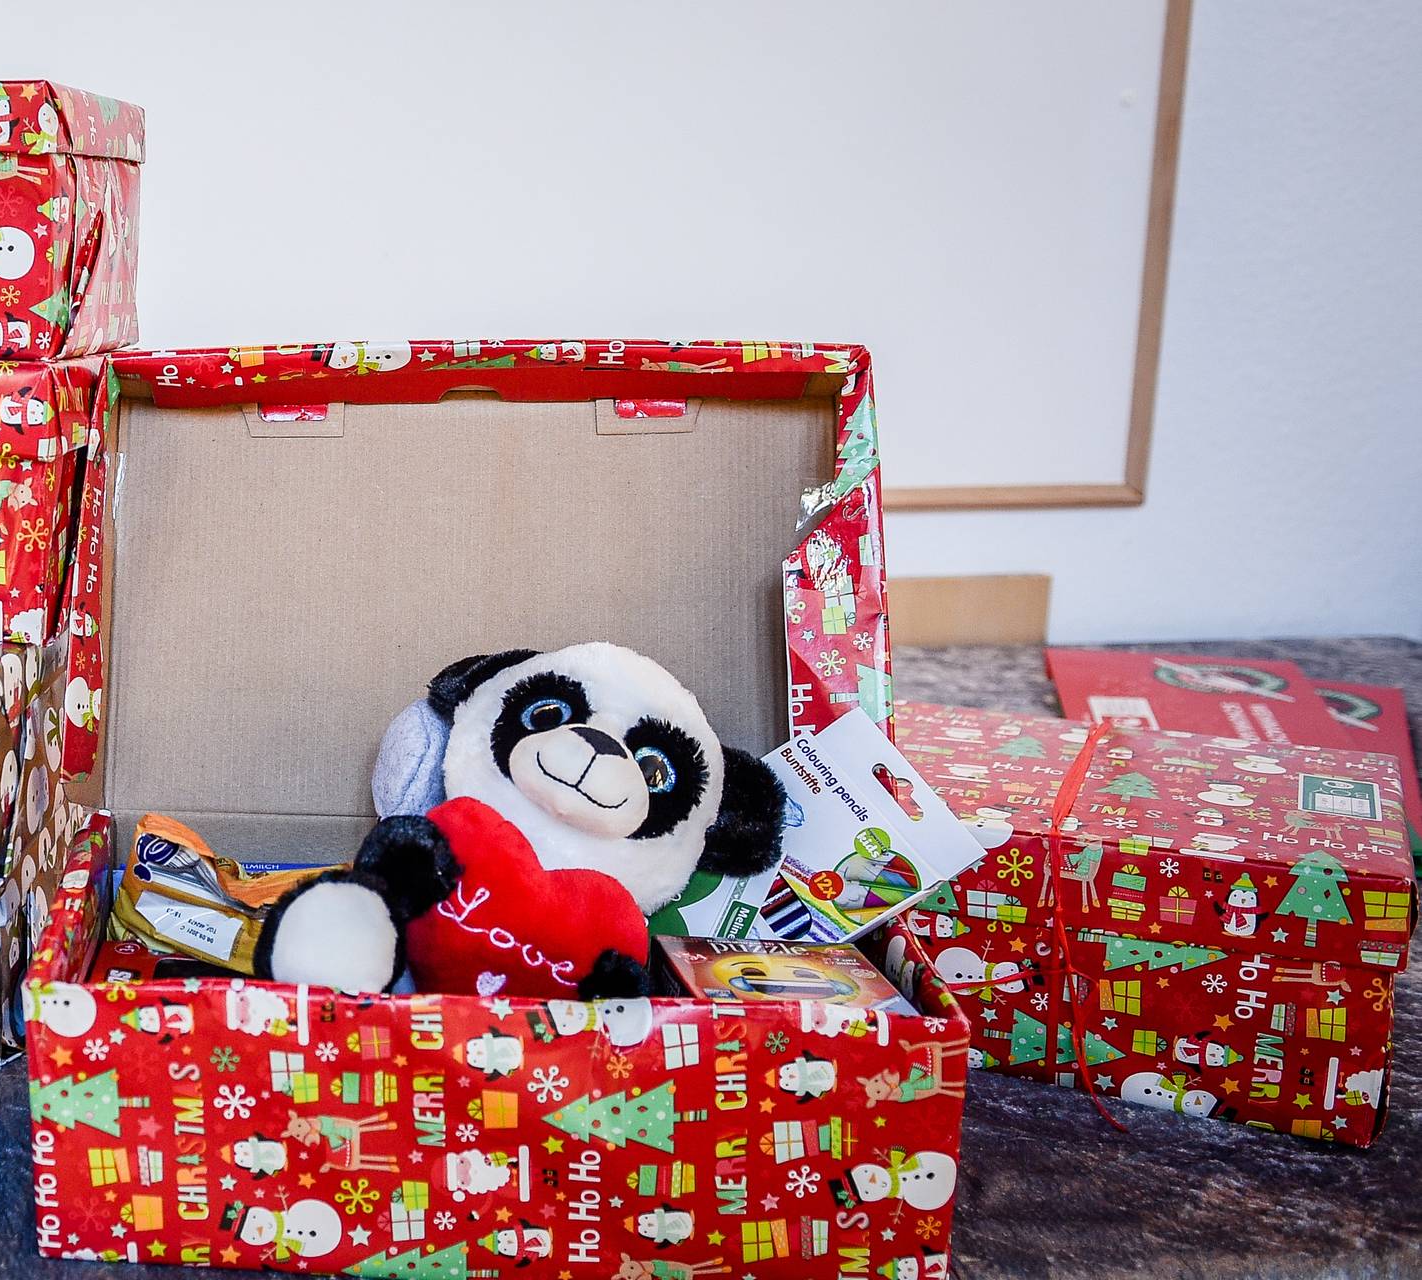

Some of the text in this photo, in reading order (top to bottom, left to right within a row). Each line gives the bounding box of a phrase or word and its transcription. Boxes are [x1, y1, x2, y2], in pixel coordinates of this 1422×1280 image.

[598, 340, 627, 366] Ho
[155, 363, 182, 388] Ho
[85, 486, 103, 594] Ho Ho Ho
[780, 747, 821, 795] Buntstifte
[796, 738, 869, 822] Colouring pencils
[992, 761, 1024, 772] Ho
[1032, 765, 1064, 777] Ho
[856, 831, 881, 860] kids
[1262, 832, 1395, 857] Ho Ho Ho
[437, 880, 577, 987] Love
[1234, 988, 1268, 1020] Ho
[31, 1129, 63, 1250] Ho Ho Ho
[568, 1149, 602, 1264] Ho Ho Ho
